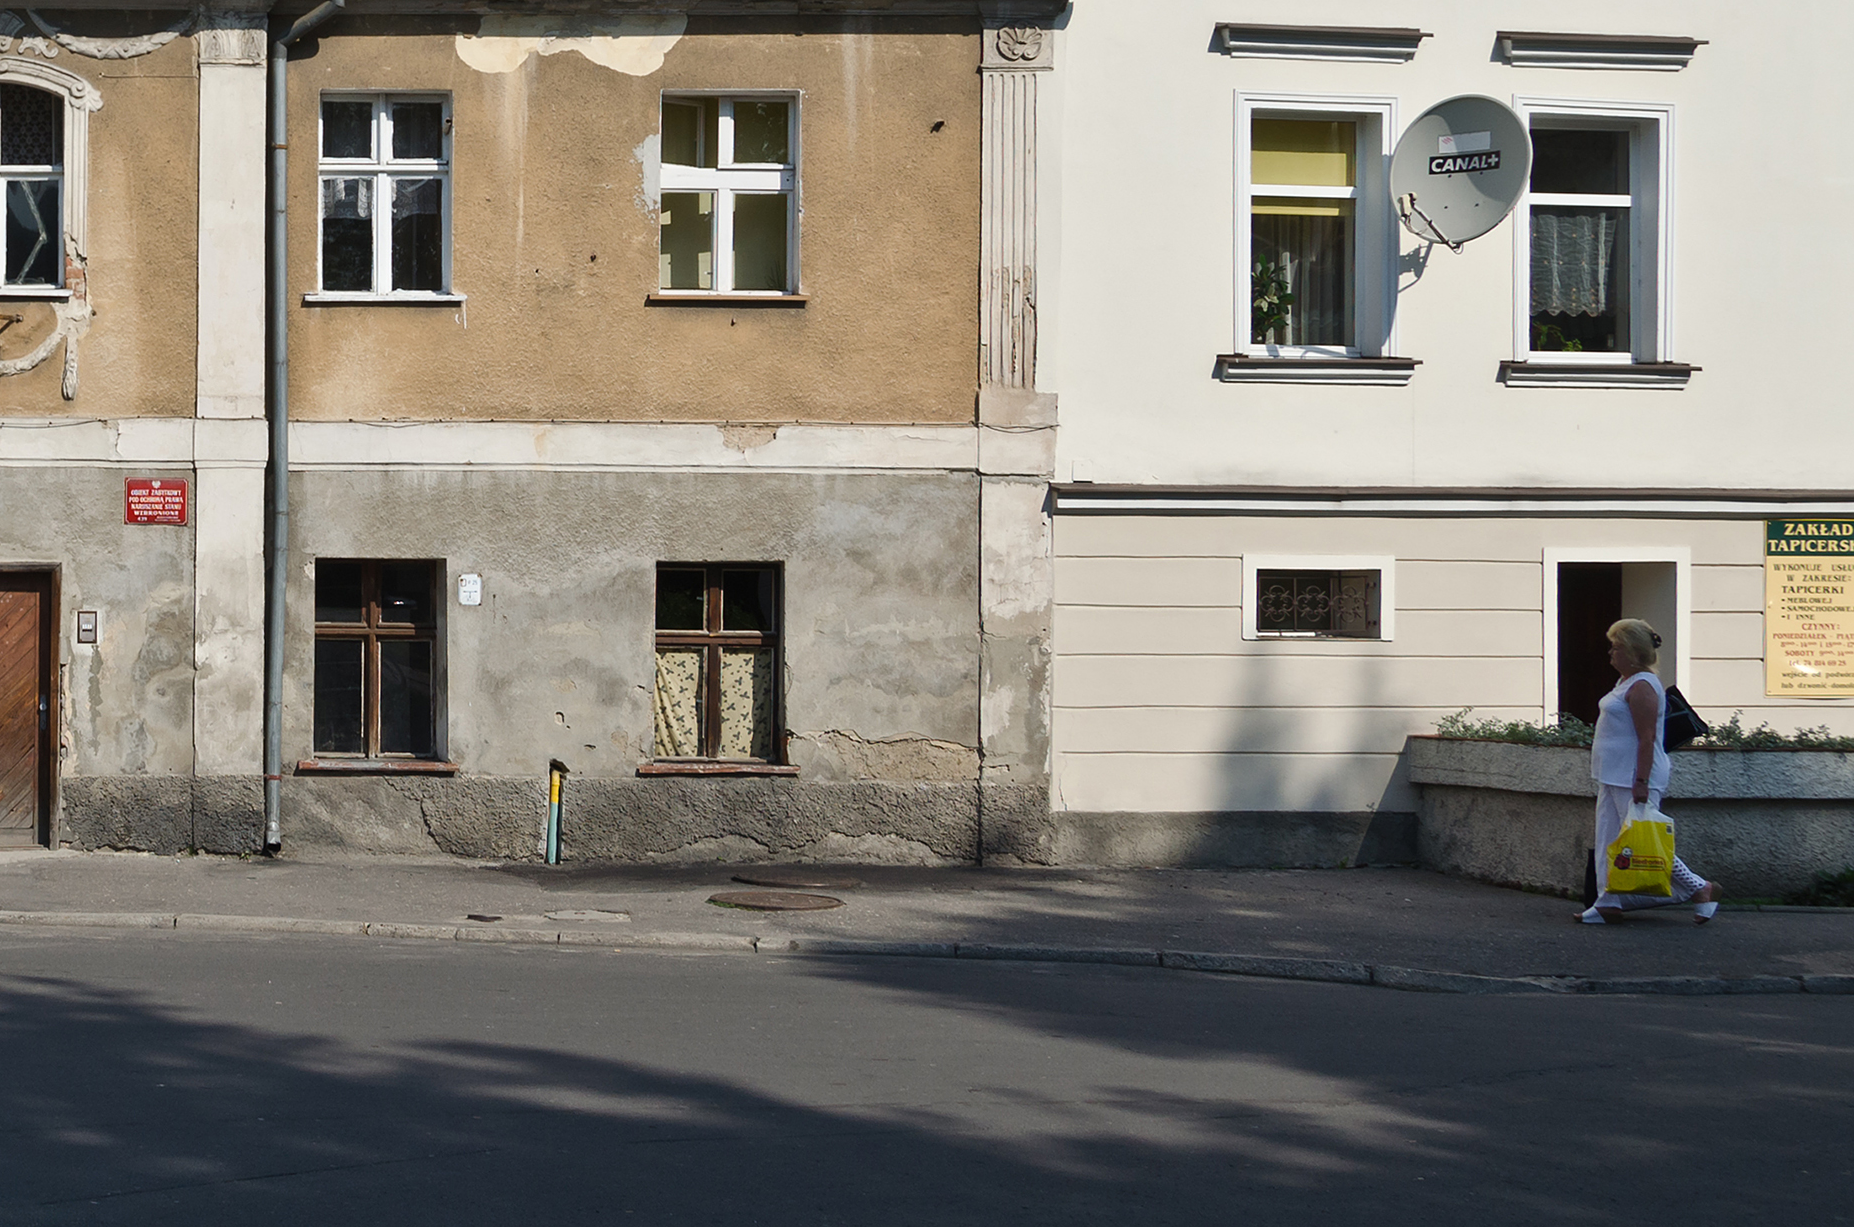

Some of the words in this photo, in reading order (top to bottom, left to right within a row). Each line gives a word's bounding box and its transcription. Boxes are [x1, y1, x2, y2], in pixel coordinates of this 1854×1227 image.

[1431, 154, 1499, 173] CANAL+
[1783, 523, 1854, 536] ZAKŁAD
[1786, 574, 1794, 582] W
[1802, 574, 1852, 582] ZAKRESIE:
[1781, 585, 1844, 594] TAPICERKI
[1801, 623, 1840, 631] CZYNNY:
